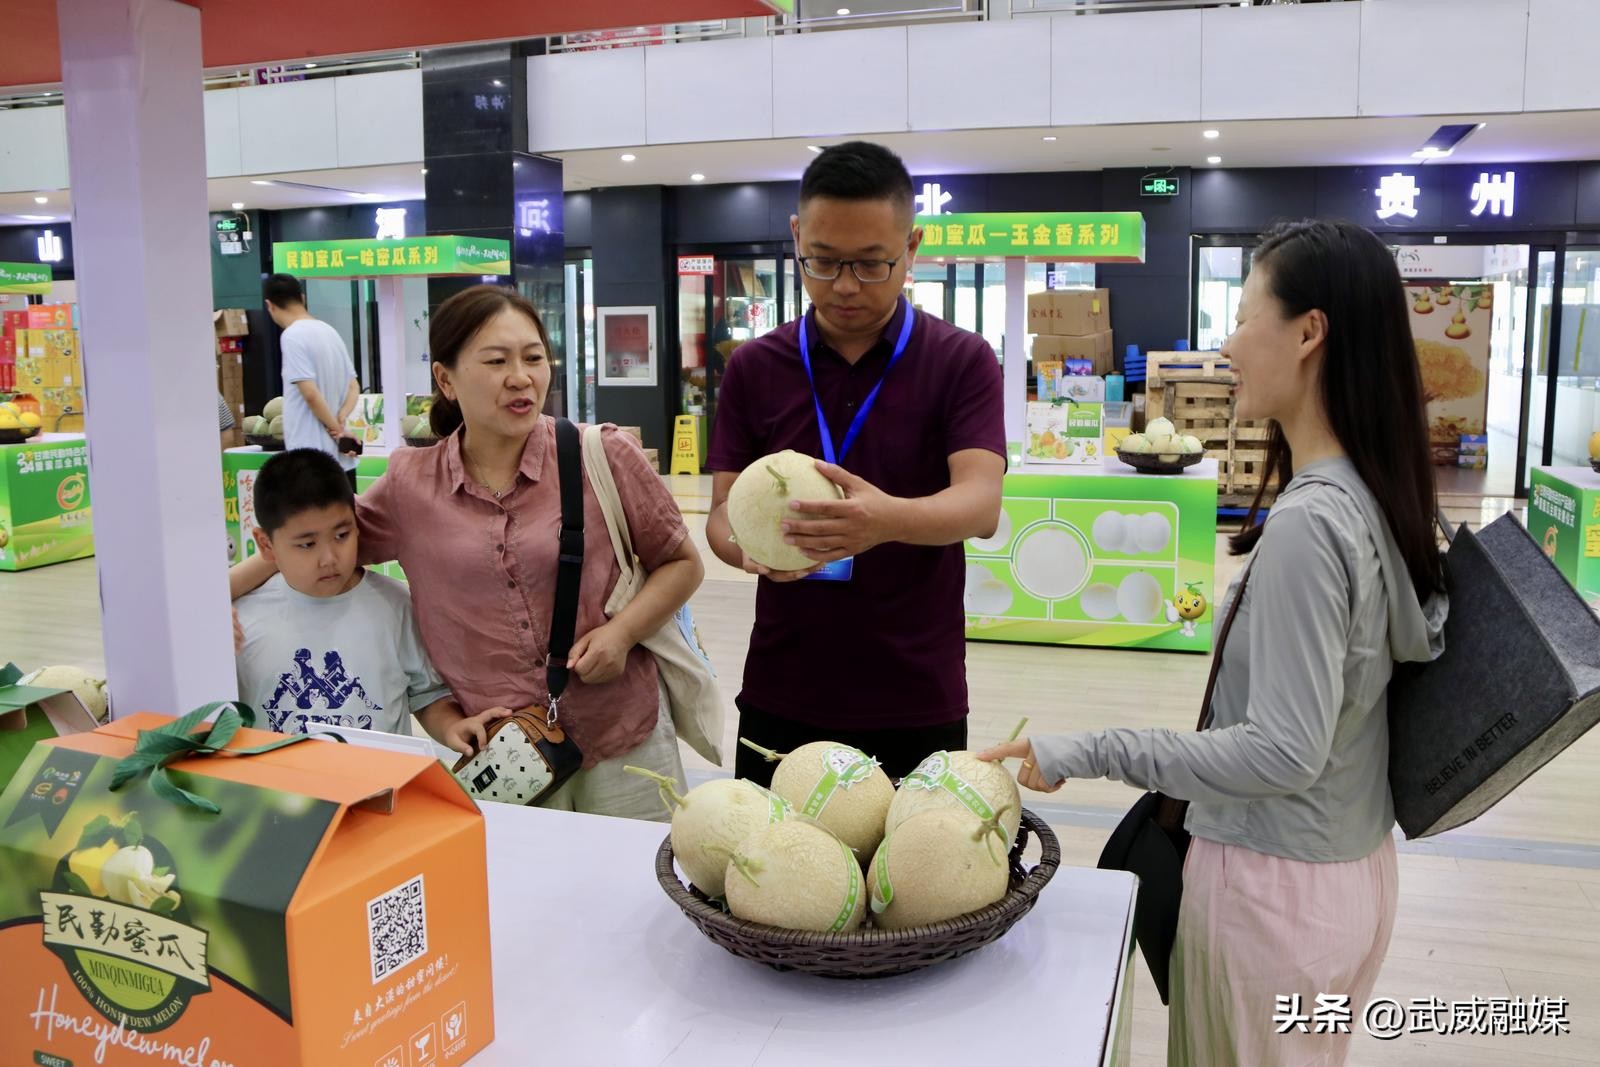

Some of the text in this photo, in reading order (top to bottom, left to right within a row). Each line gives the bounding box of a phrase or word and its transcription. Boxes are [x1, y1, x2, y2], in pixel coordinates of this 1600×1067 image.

[1374, 171, 1516, 220] 贵州
[37, 229, 64, 262] 山
[1424, 711, 1519, 797] BELIEVE IN BETTER
[56, 903, 196, 971] 民勤蜜瓜
[72, 969, 95, 1001] 100%
[152, 995, 184, 1029] MELON
[89, 958, 165, 997] MINQINMIGUA
